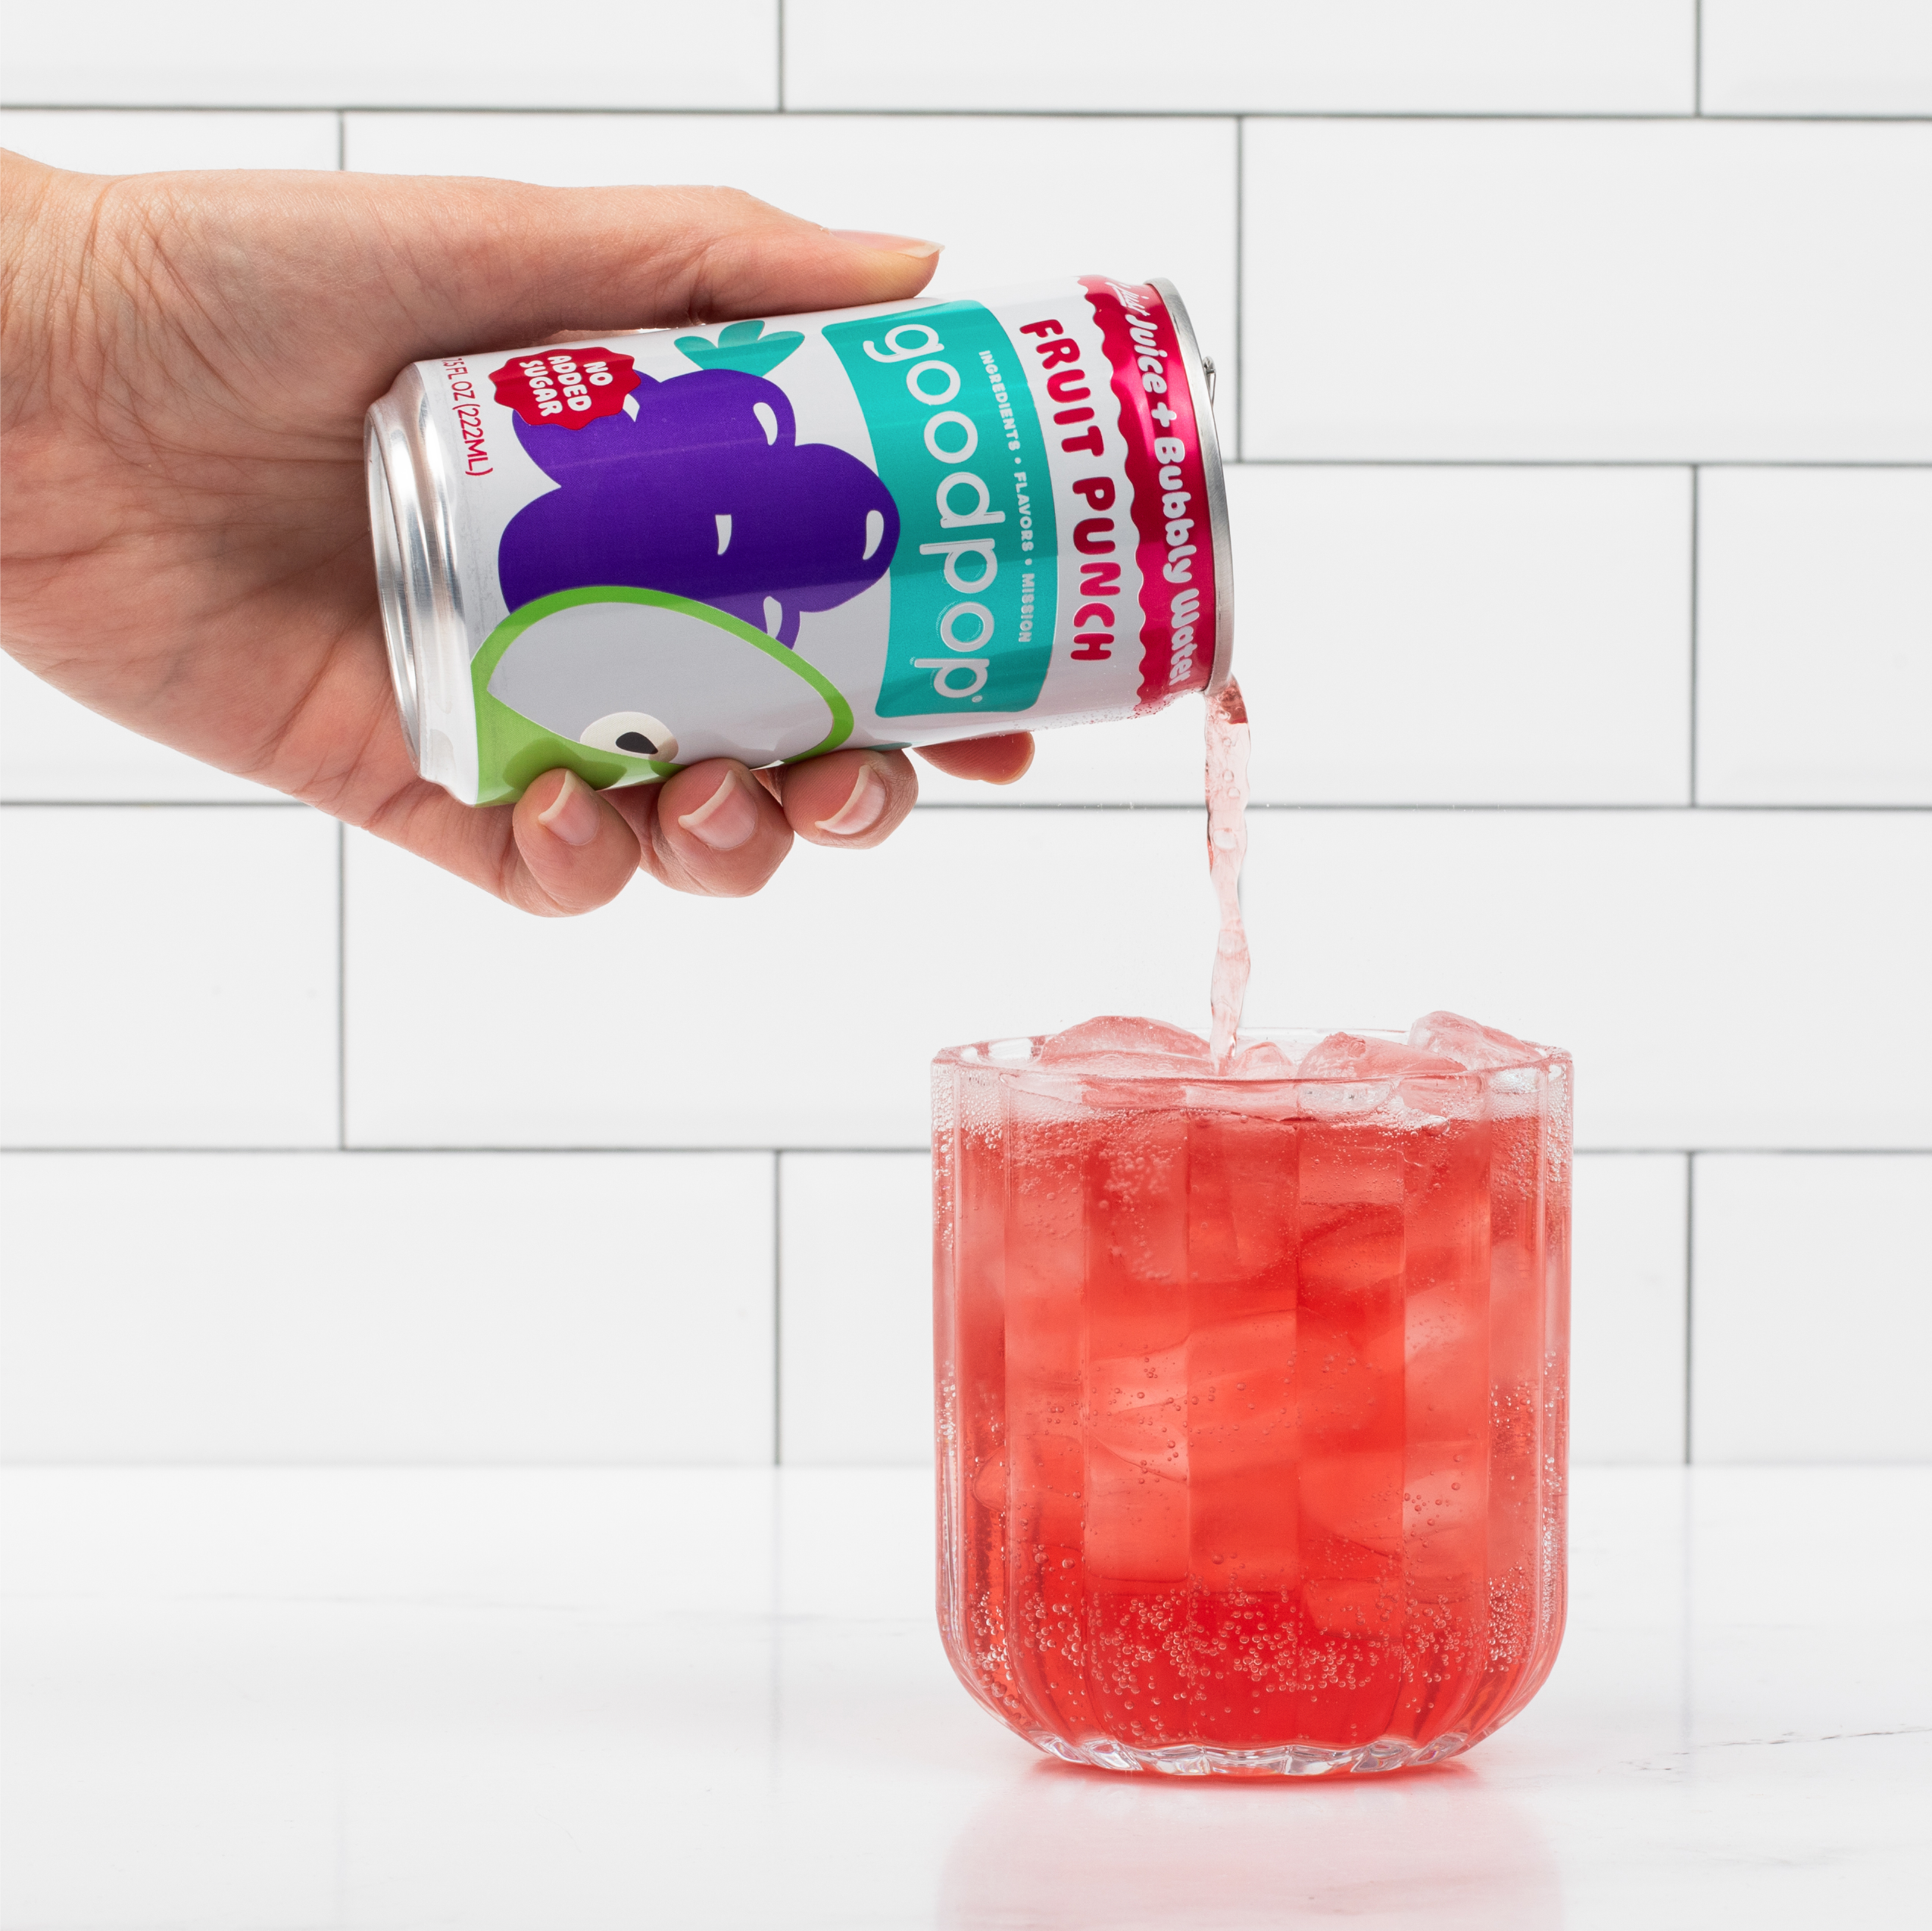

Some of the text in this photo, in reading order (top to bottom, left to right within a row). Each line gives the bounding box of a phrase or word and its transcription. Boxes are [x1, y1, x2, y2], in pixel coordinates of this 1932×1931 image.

[519, 360, 563, 416] SUGAR
[548, 355, 591, 411] ADDED
[583, 361, 613, 386] NO
[1125, 314, 1168, 394] Juice
[451, 381, 476, 401] OZ
[1151, 402, 1177, 427] +
[452, 404, 493, 476] (222ML)
[978, 350, 1035, 642] INGREDIENTS FLAVORS MISSION
[1019, 319, 1121, 661] FRUIT PUNCH
[1154, 437, 1197, 583] Bubbly
[1169, 588, 1200, 687] Water
